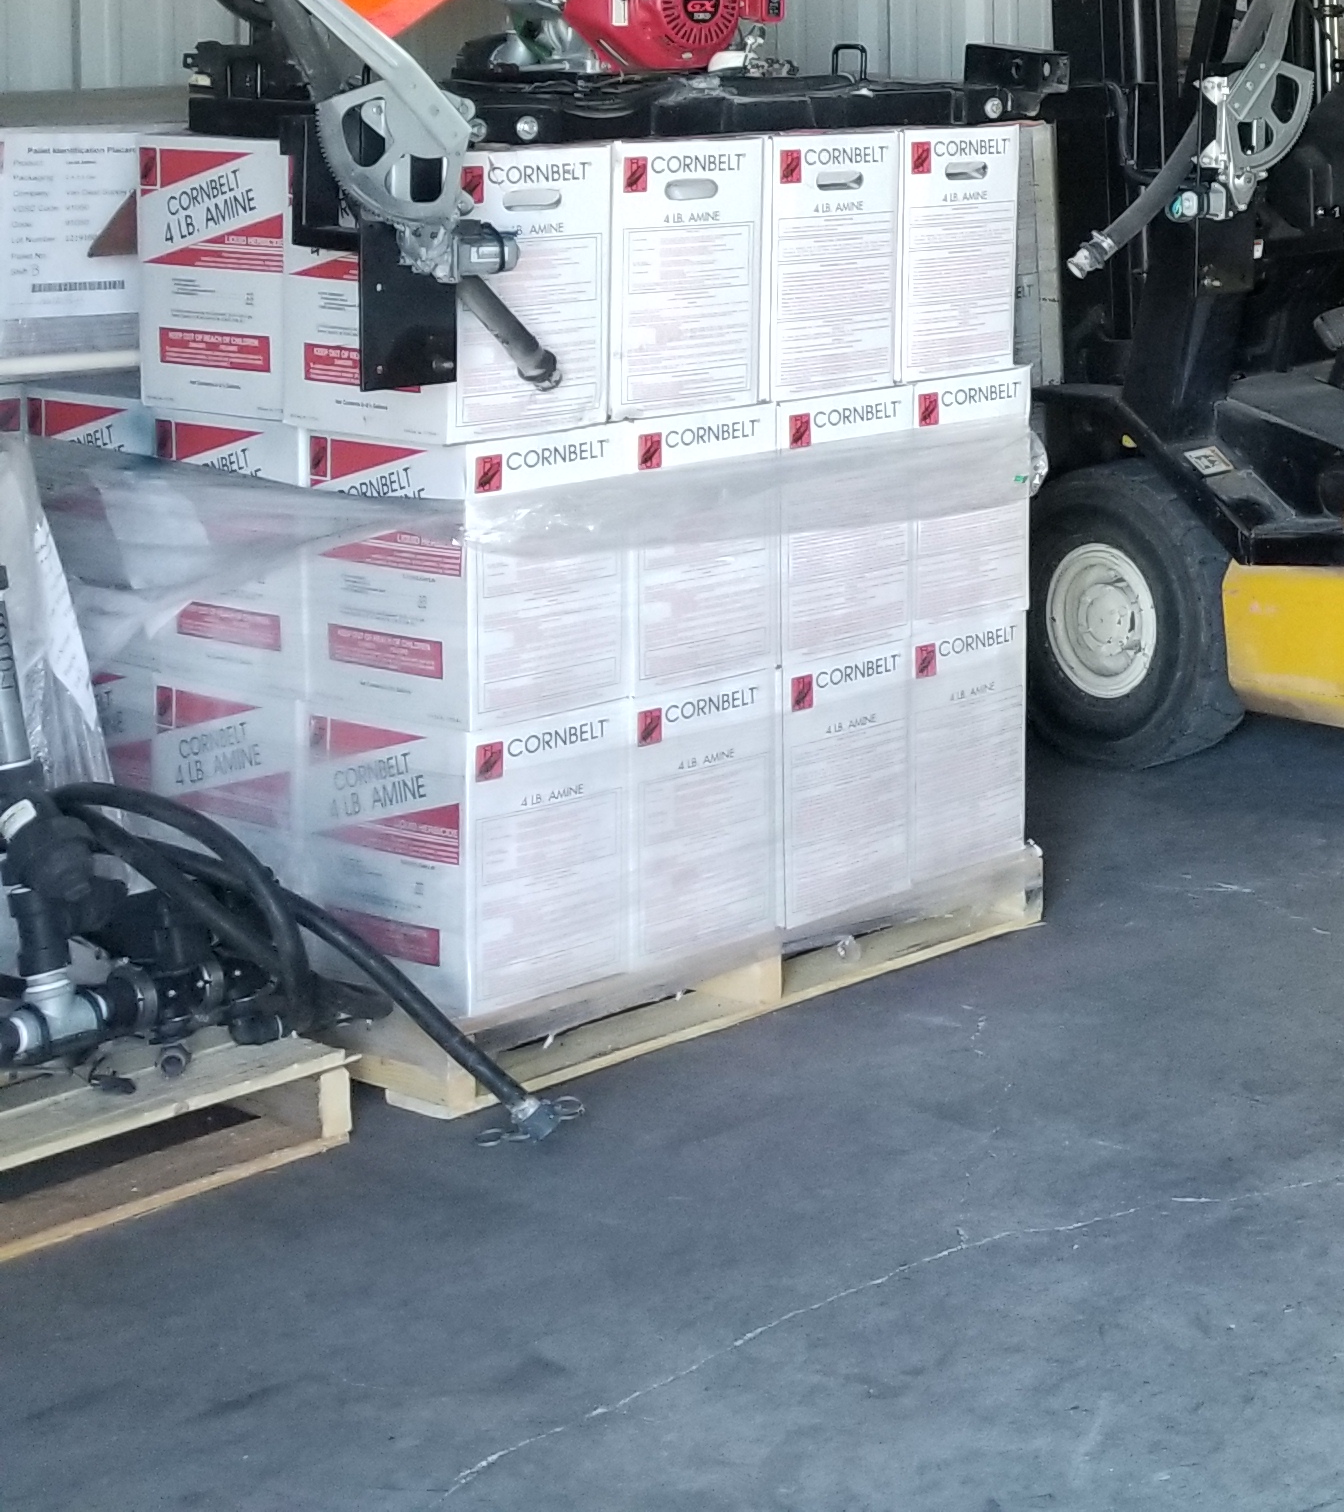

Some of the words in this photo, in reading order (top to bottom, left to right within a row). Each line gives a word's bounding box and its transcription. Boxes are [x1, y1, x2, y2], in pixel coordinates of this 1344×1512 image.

[687, 0, 717, 12] GX
[804, 146, 886, 166] CORNBELT
[934, 138, 1008, 158] CORNBELT
[487, 162, 590, 185] CORNBELT
[651, 154, 744, 174] CORNBELT
[167, 168, 240, 215] CORNBELT
[942, 193, 949, 202] 4
[962, 190, 988, 201] AMINE
[165, 222, 174, 243] 4
[177, 215, 200, 240] LB.
[205, 188, 256, 229] AMINE
[663, 214, 671, 223] 4
[688, 211, 721, 222] AMINE
[813, 203, 821, 213] 4
[835, 201, 864, 212] AMINE
[530, 222, 564, 234] AMINE
[941, 382, 1020, 407] CORNBELT
[813, 401, 899, 428] CORNBELT
[665, 420, 758, 449] CORNBELT
[507, 440, 606, 470] CORNBELT
[939, 625, 1016, 657] CORNBELT
[816, 654, 899, 688] CORNBELT
[665, 687, 757, 723] CORNBELT
[826, 725, 832, 734] 4
[849, 713, 877, 728] AMINE
[178, 721, 247, 760] CORNBELT
[507, 719, 607, 757] CORNBELT
[175, 764, 186, 786] 4
[213, 744, 262, 775] AMINE
[333, 752, 411, 792] CORNBELT
[678, 761, 685, 771] 4
[703, 748, 735, 764] AMINE
[371, 774, 427, 809] AMINE
[520, 797, 529, 807] 4
[548, 784, 584, 802] AMINE
